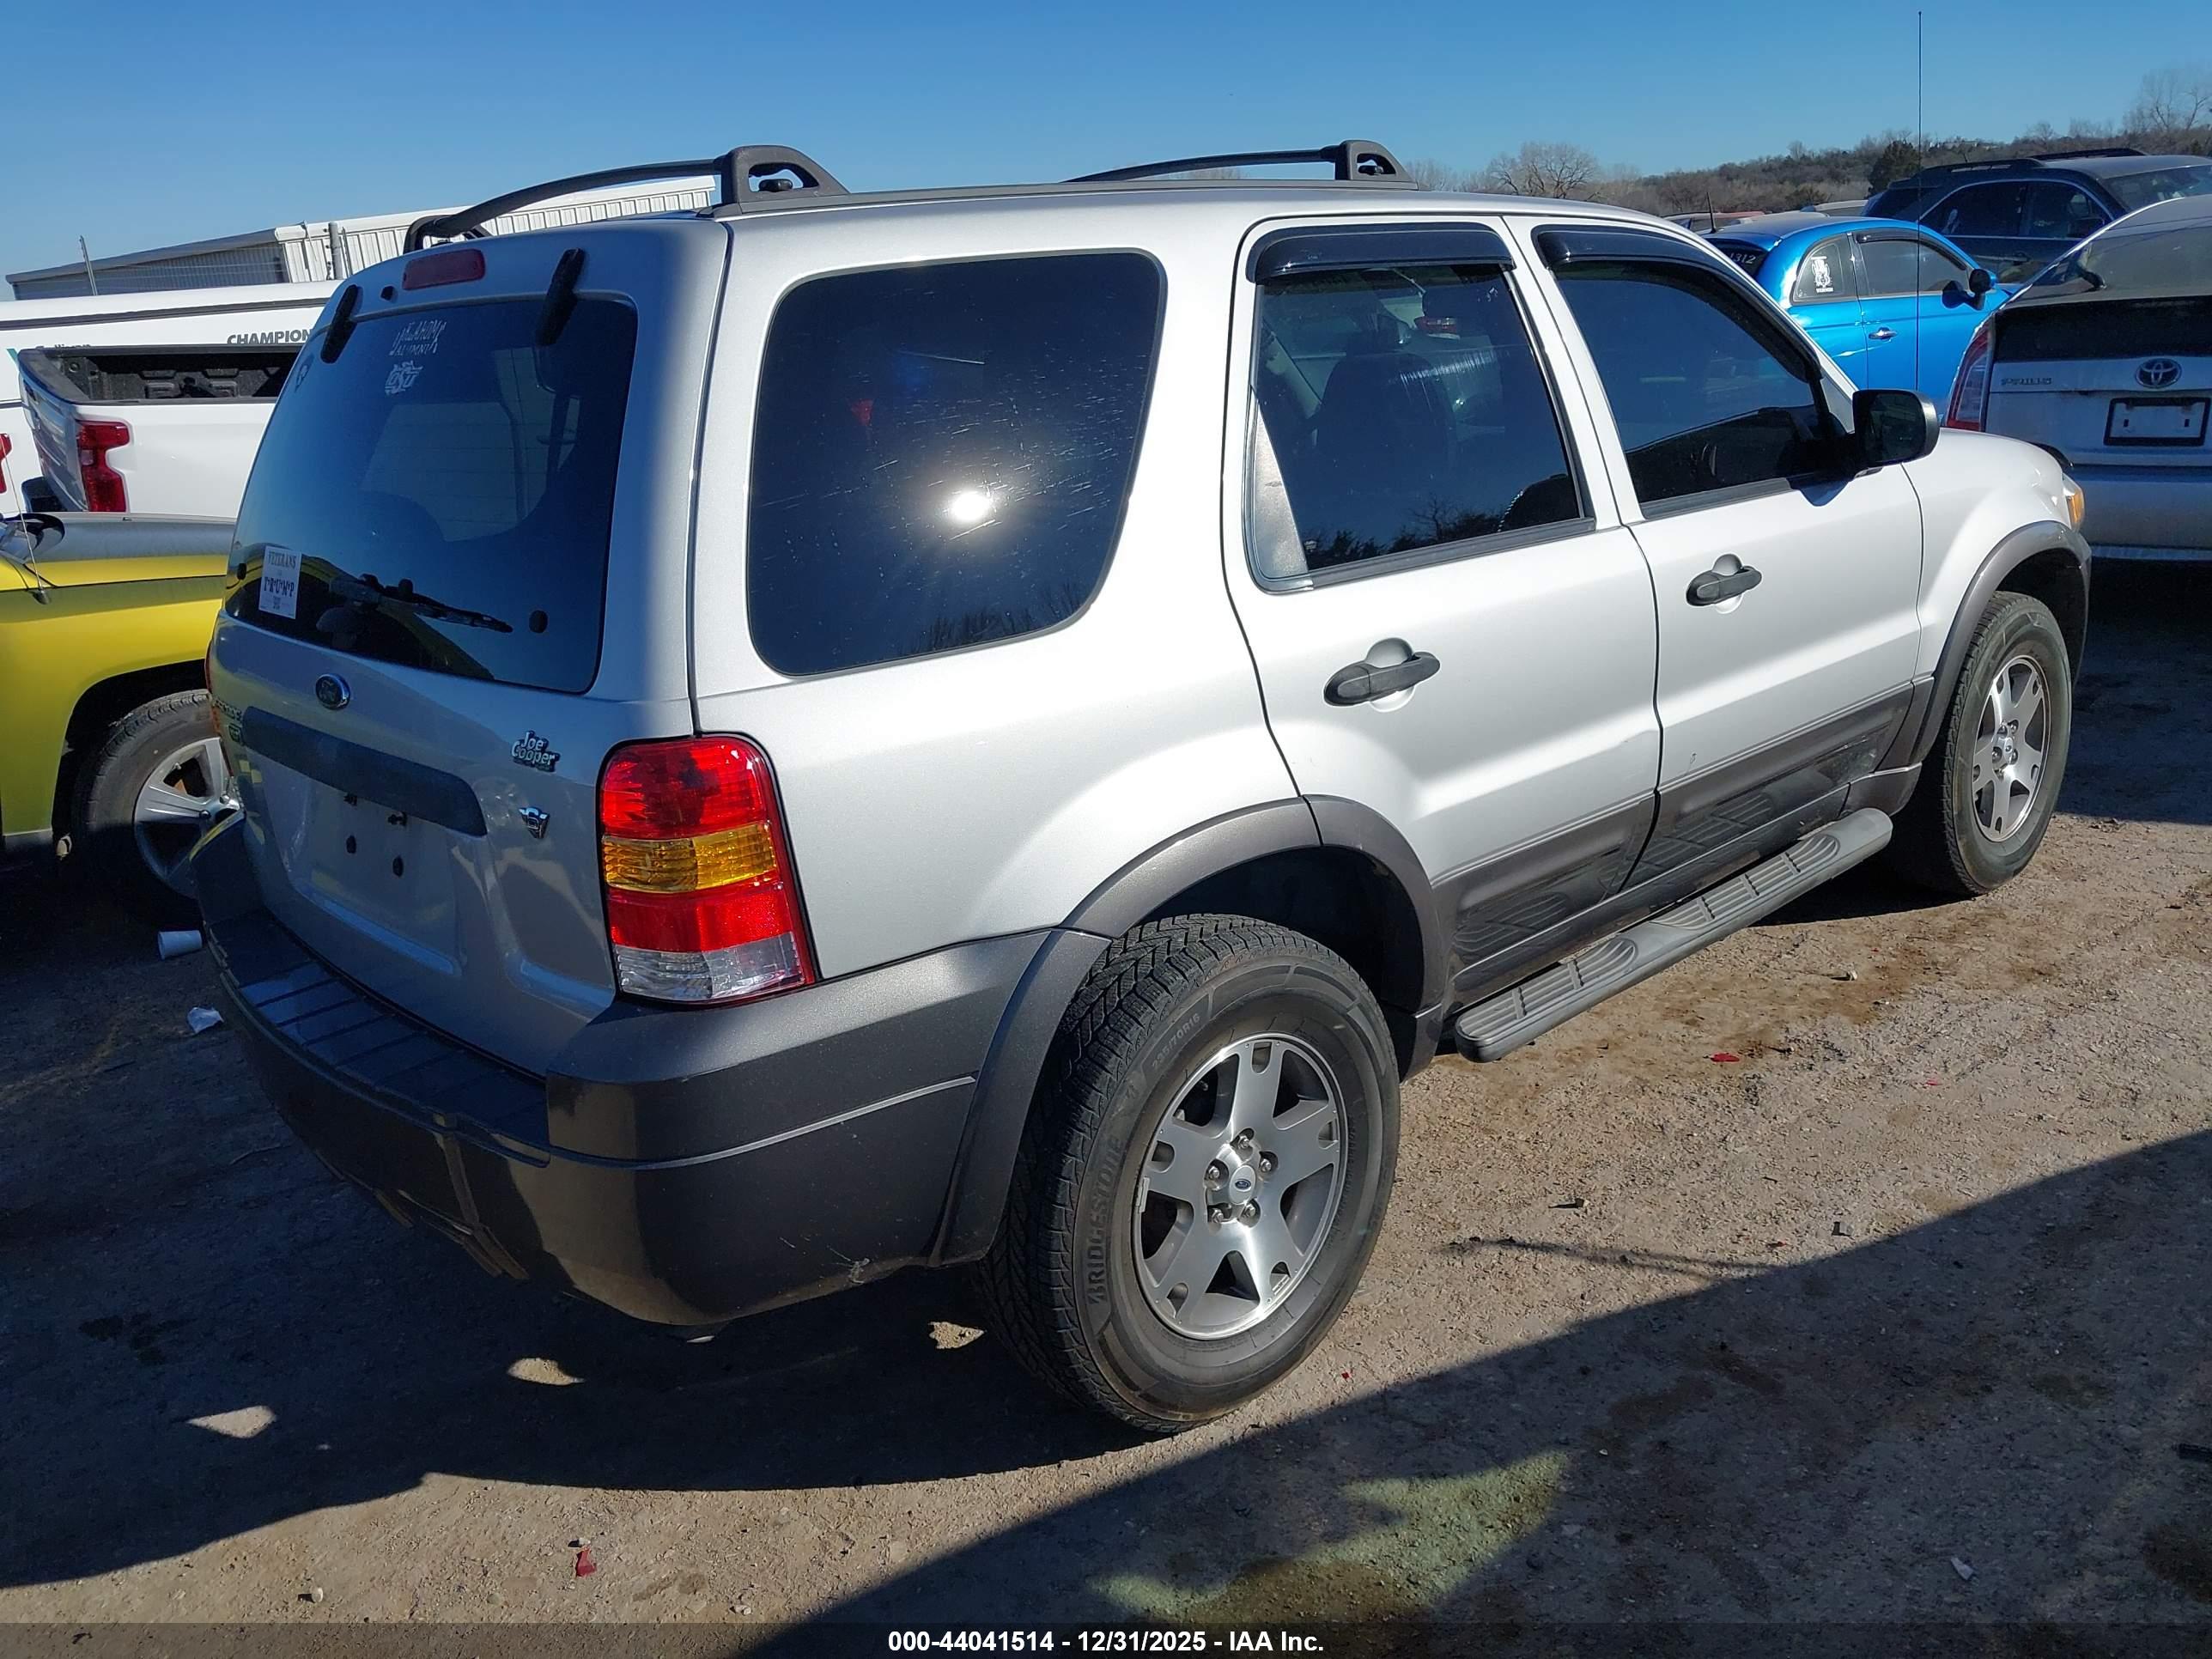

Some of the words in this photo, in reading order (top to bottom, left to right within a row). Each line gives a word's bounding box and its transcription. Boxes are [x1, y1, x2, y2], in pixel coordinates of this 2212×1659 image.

[227, 329, 313, 343] CHAMPION
[521, 731, 544, 750] Joe
[512, 740, 556, 765] Cooper
[1086, 1133, 1122, 1305] BRIDGESTONE
